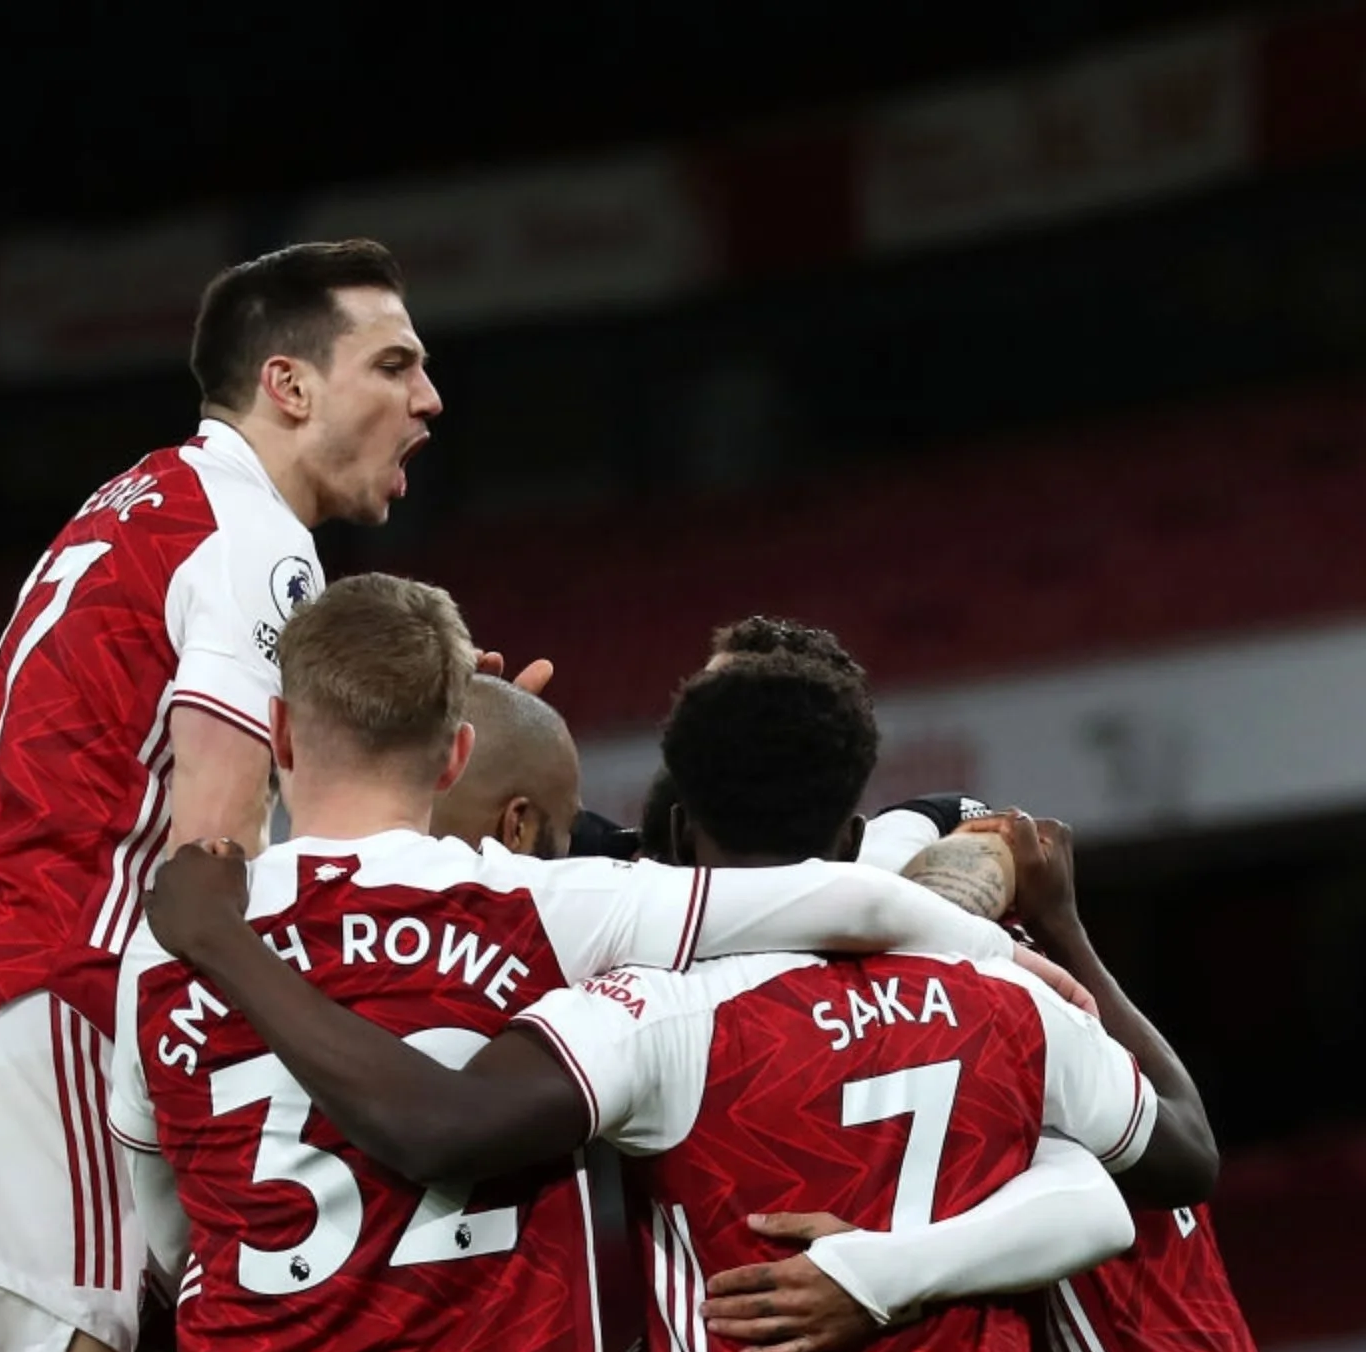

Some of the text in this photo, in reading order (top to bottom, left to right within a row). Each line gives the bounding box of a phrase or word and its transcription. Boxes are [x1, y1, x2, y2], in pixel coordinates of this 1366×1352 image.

[75, 474, 164, 522] EDRIC
[158, 914, 530, 1077] SMH ROWE
[583, 979, 646, 1020] ANDA
[812, 976, 959, 1051] SAKA
[211, 1028, 519, 1296] 32
[842, 1059, 962, 1232] 7
